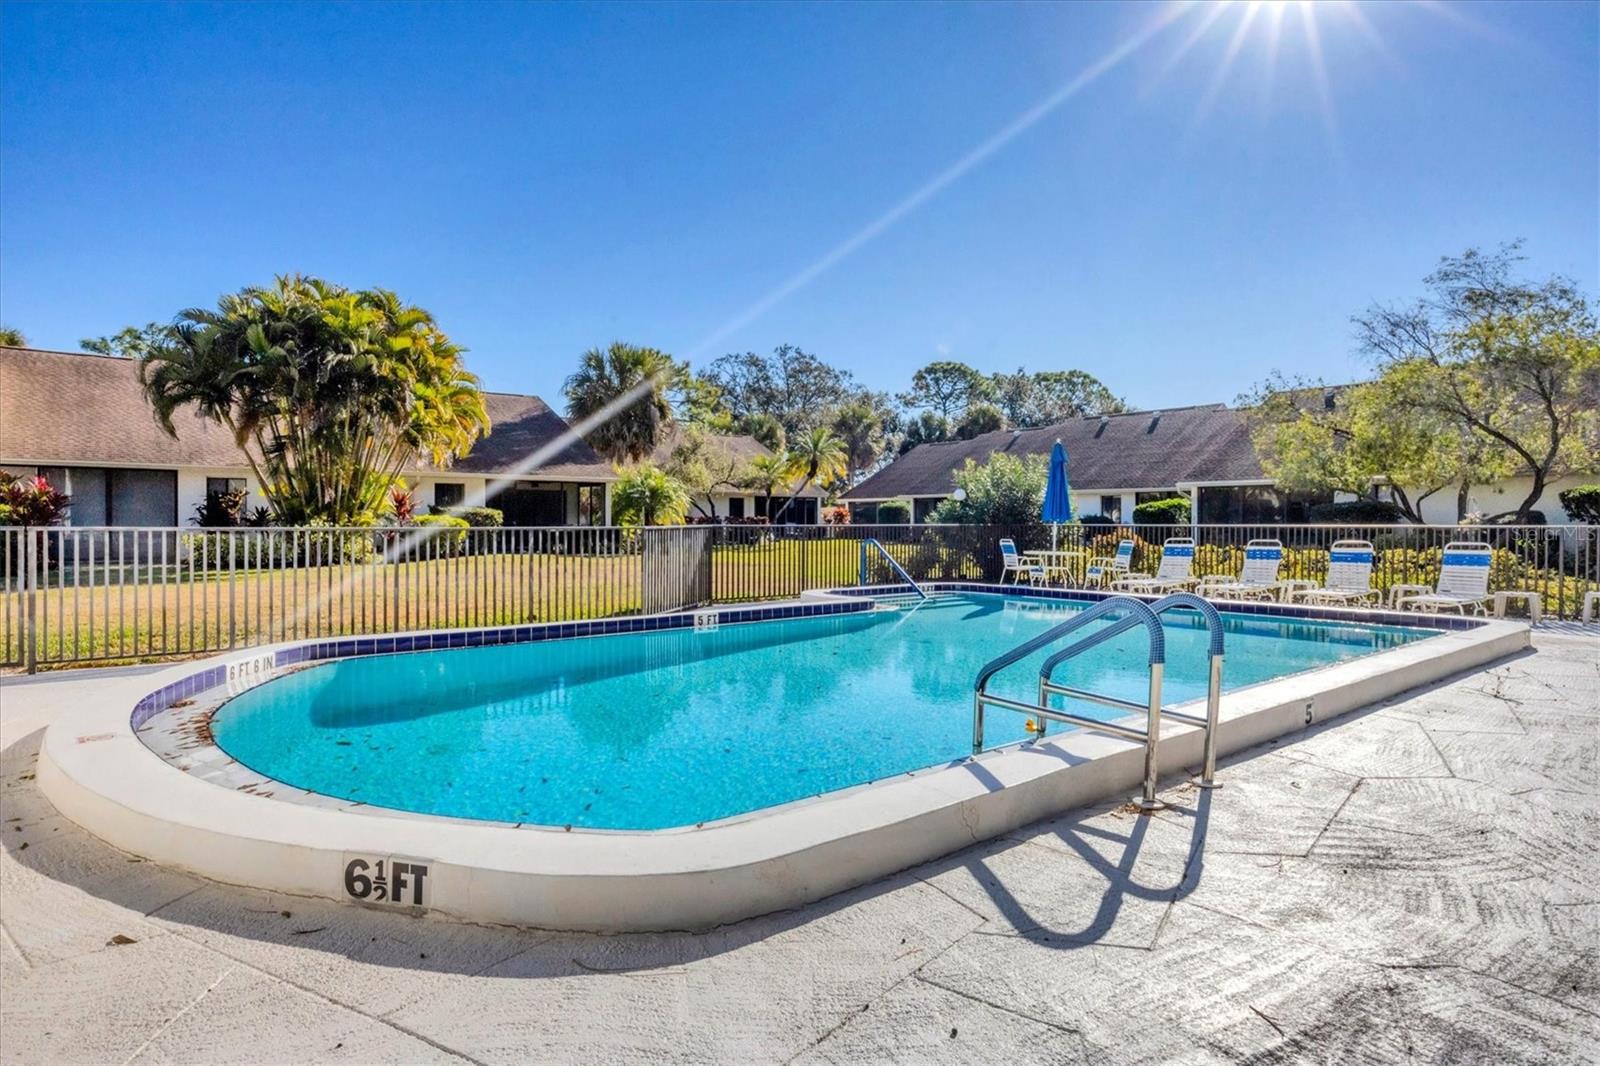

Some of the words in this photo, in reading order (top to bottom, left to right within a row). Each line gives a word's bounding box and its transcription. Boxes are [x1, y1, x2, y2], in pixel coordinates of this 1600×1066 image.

[698, 615, 704, 626] 5
[706, 614, 718, 625] FT
[229, 665, 236, 681] 6
[239, 661, 250, 677] FT
[254, 658, 259, 673] 6
[263, 655, 273, 671] IN
[1305, 703, 1312, 724] 5
[392, 861, 428, 905] FT
